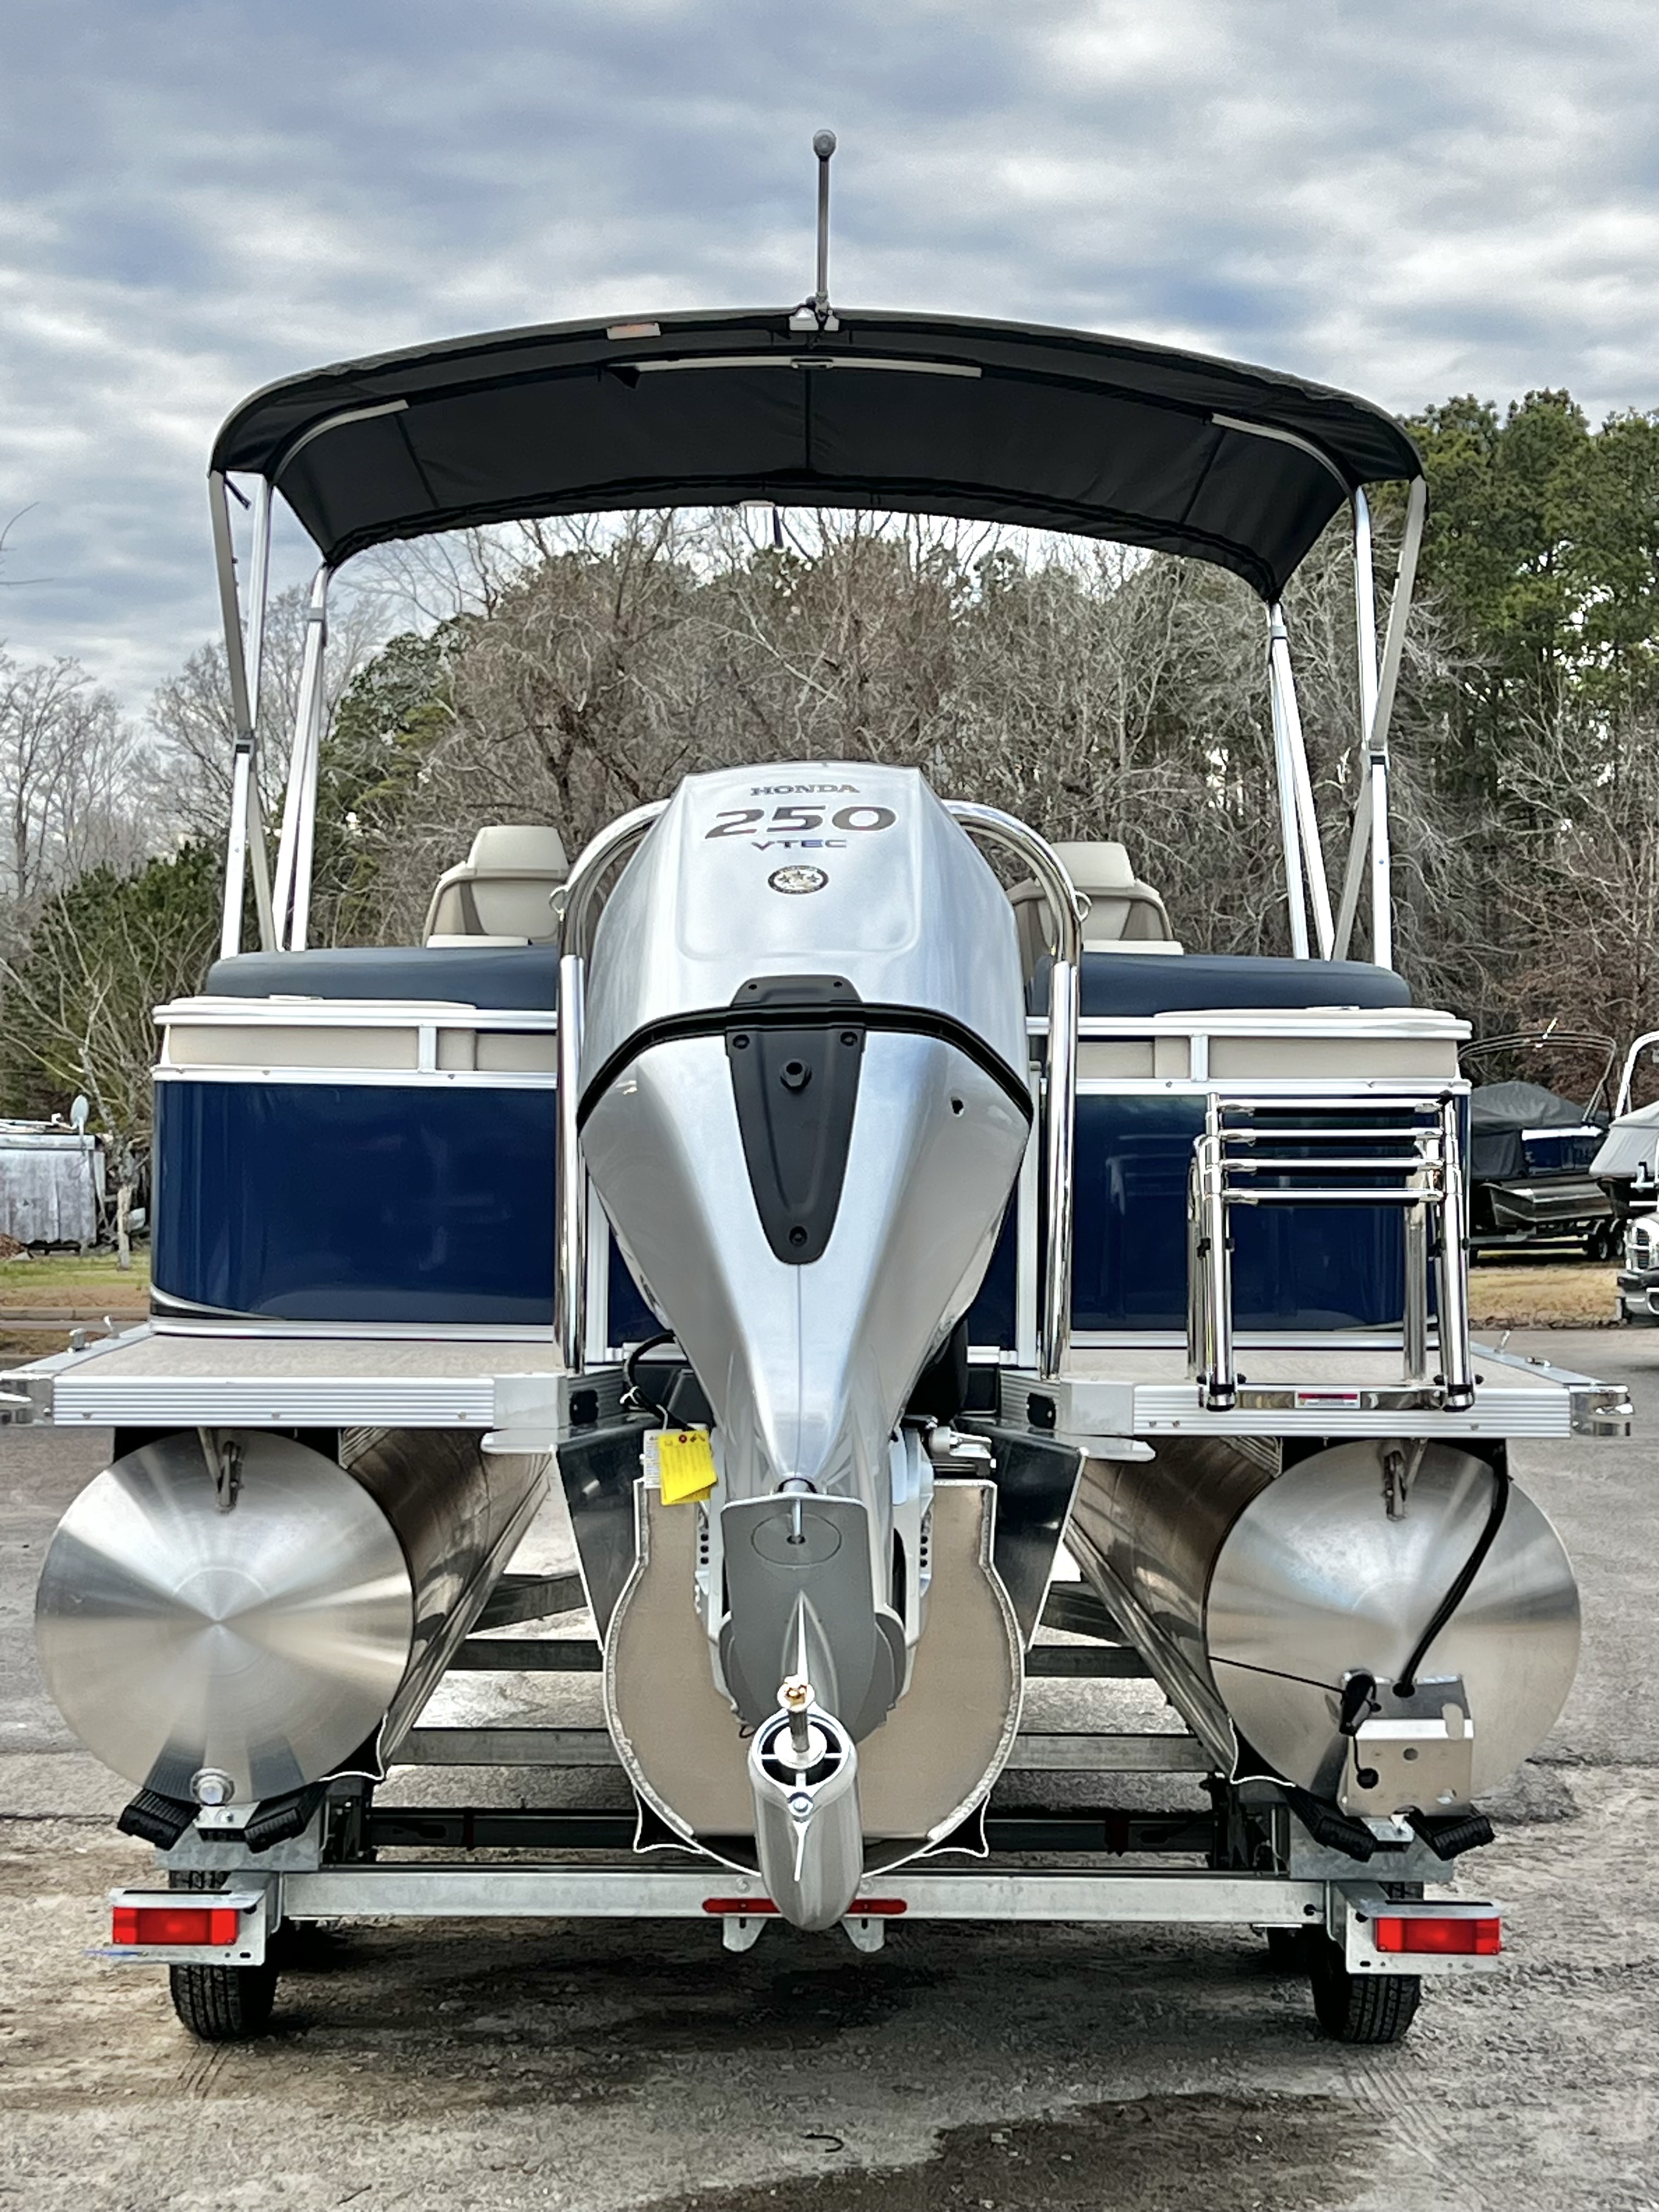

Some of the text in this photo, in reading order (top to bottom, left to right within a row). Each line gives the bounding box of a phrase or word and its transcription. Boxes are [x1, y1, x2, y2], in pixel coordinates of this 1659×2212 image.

[750, 784, 860, 796] HONDA
[704, 805, 896, 839] 250
[751, 839, 848, 851] VTEC
